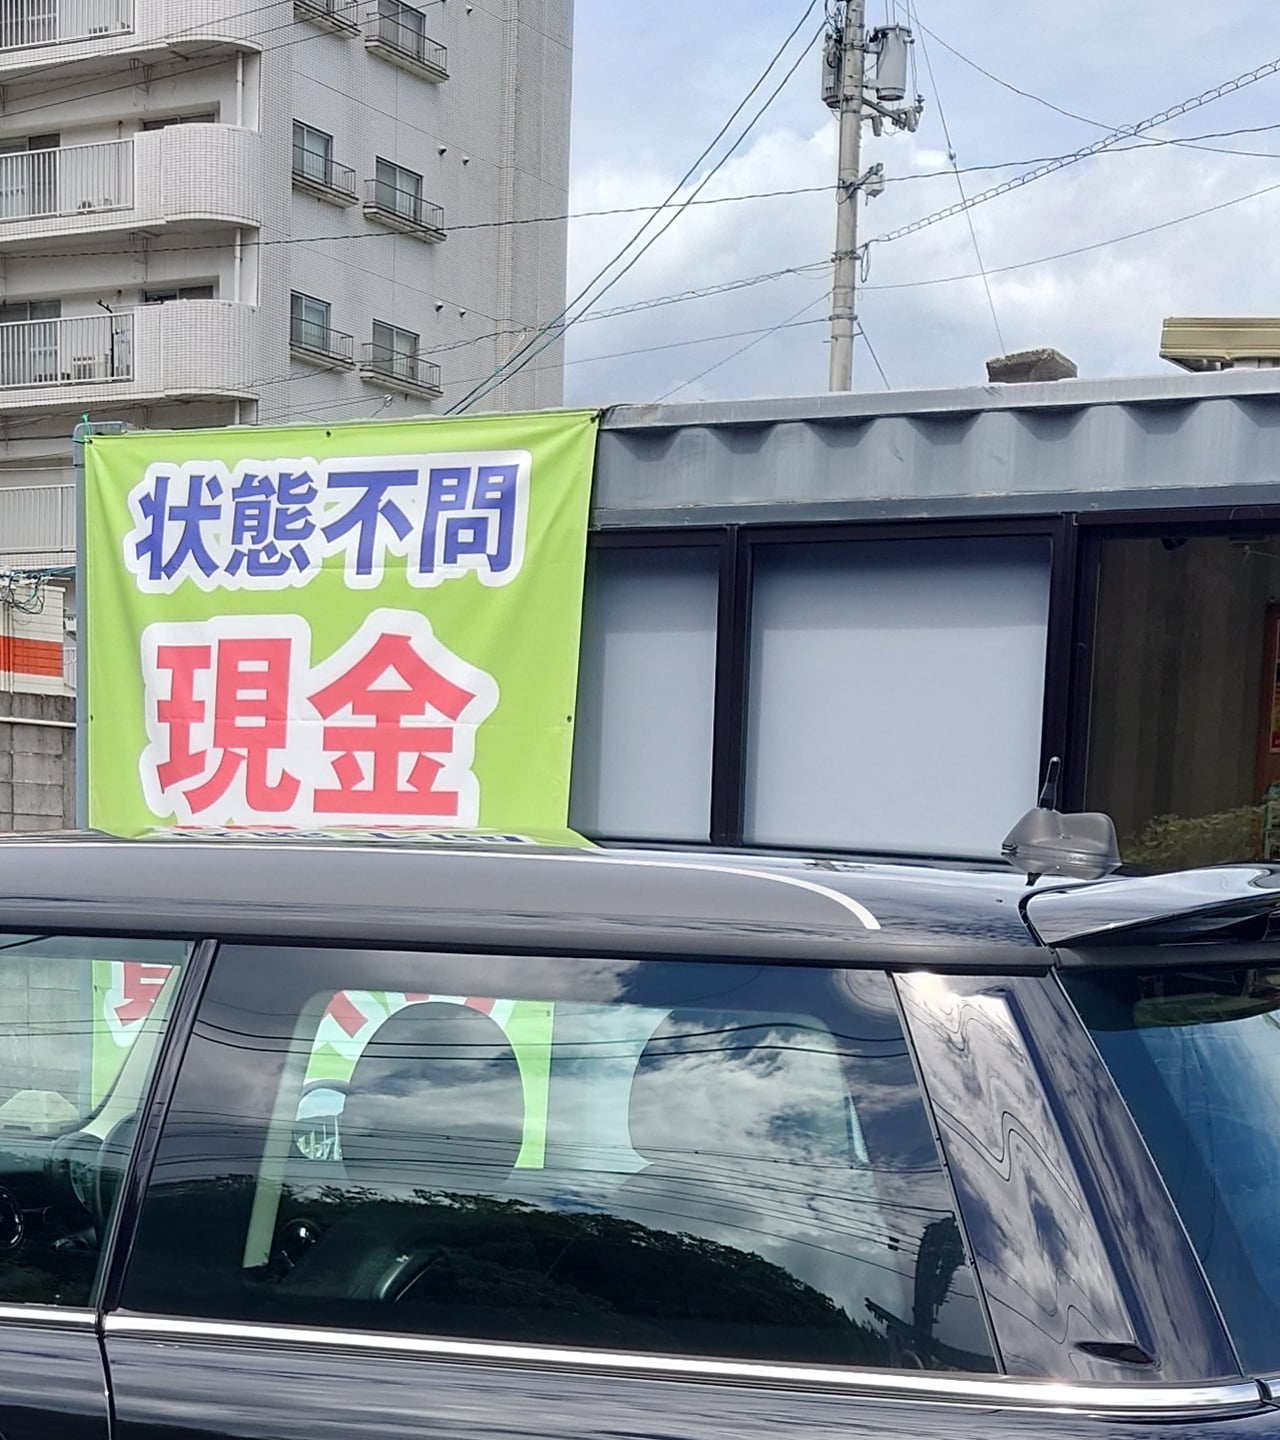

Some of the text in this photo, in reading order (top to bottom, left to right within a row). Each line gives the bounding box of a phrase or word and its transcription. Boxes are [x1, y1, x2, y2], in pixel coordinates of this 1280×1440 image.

[134, 462, 521, 581] 状態不問
[154, 631, 478, 817] 現金
